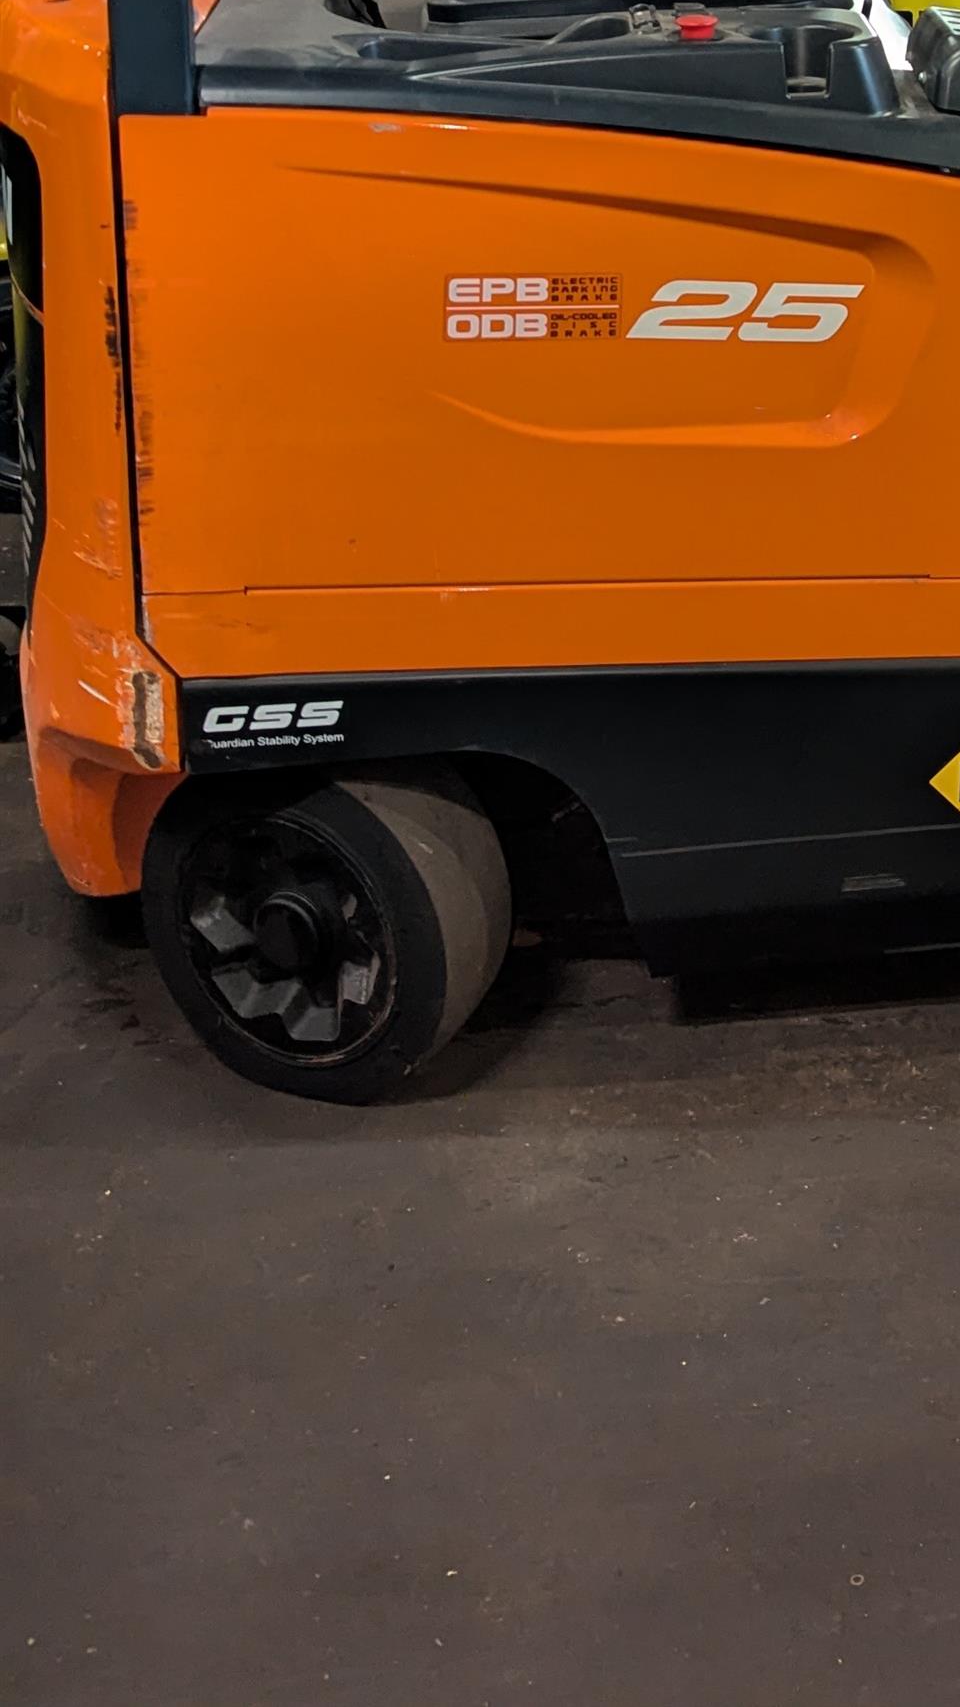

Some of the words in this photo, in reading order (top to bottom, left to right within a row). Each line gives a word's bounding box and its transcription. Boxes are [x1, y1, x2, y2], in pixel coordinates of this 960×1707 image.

[448, 277, 549, 302] EPB
[551, 277, 618, 285] ELECTRIC
[551, 285, 618, 293] PARKING
[551, 312, 617, 321] OIL-COOLED
[626, 279, 865, 343] 25
[447, 313, 549, 339] ODB
[202, 700, 344, 733] GSS
[207, 737, 255, 749] uardian
[257, 734, 301, 746] Stability
[303, 733, 345, 744] System
